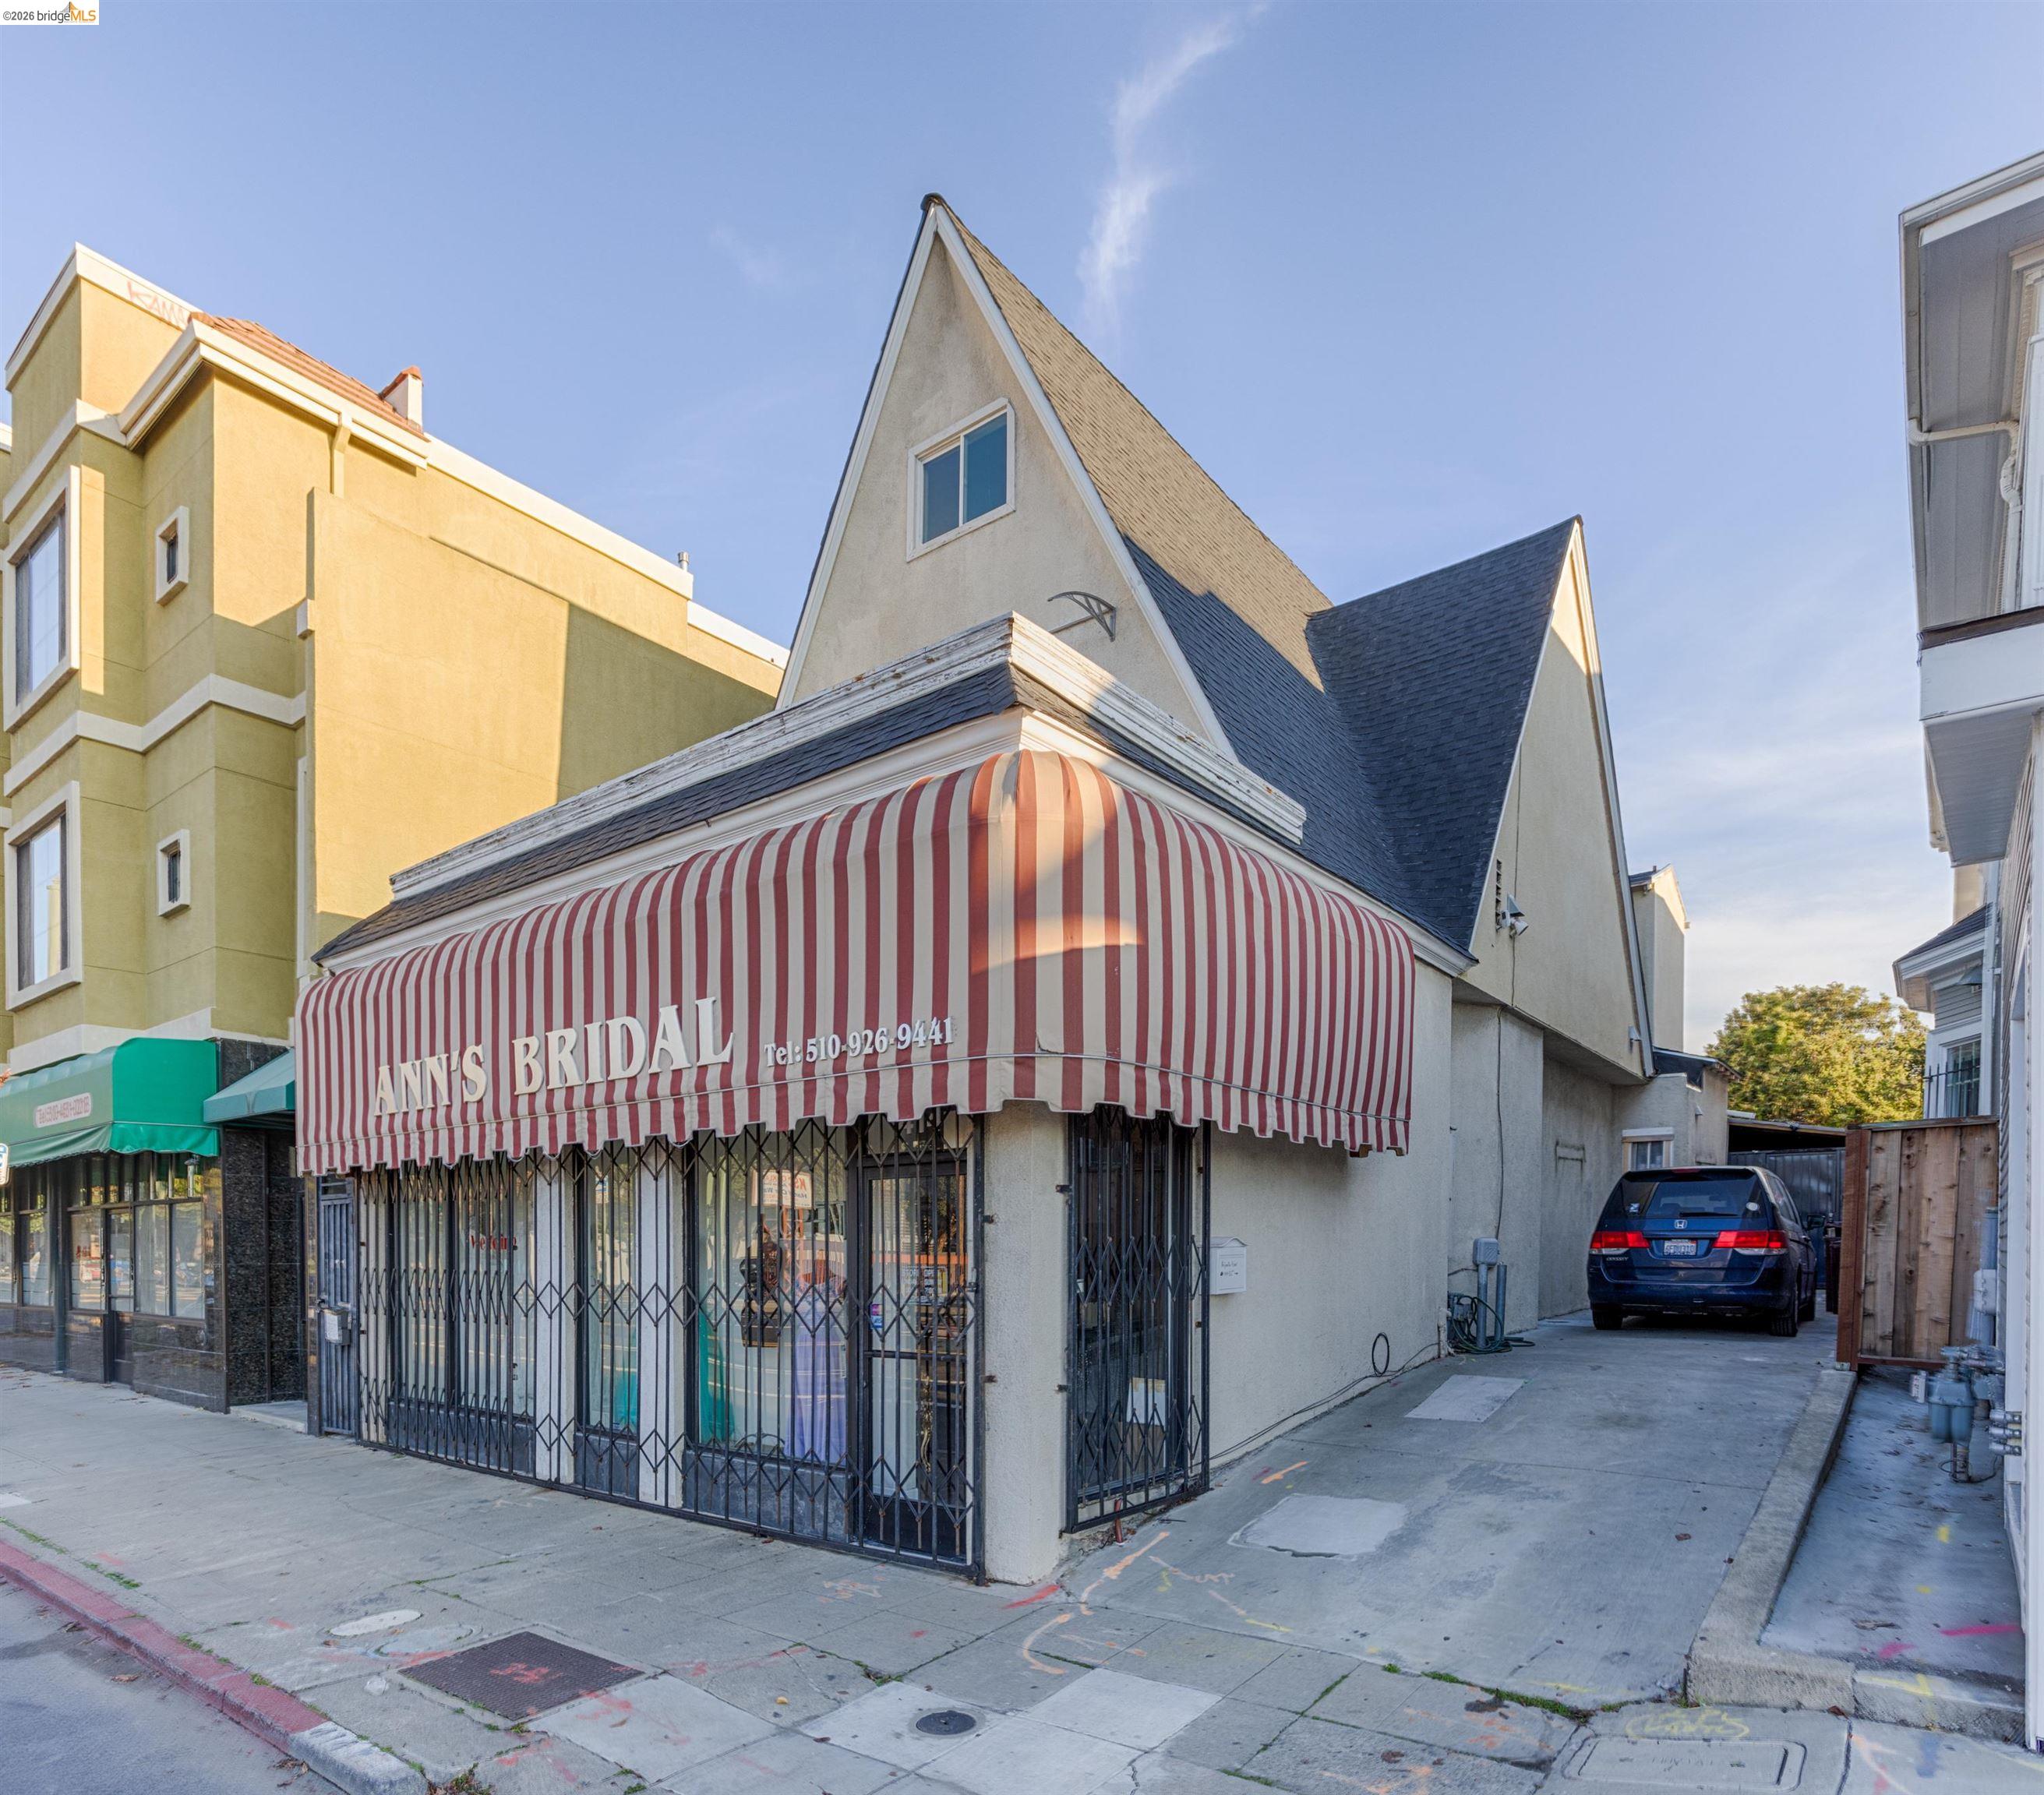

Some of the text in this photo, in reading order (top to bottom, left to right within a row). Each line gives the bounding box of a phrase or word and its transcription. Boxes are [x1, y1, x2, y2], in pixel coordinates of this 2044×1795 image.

[374, 996, 736, 1116] ANN'S BRIDAL
[764, 1017, 953, 1067] Tel: 510-926-9441
